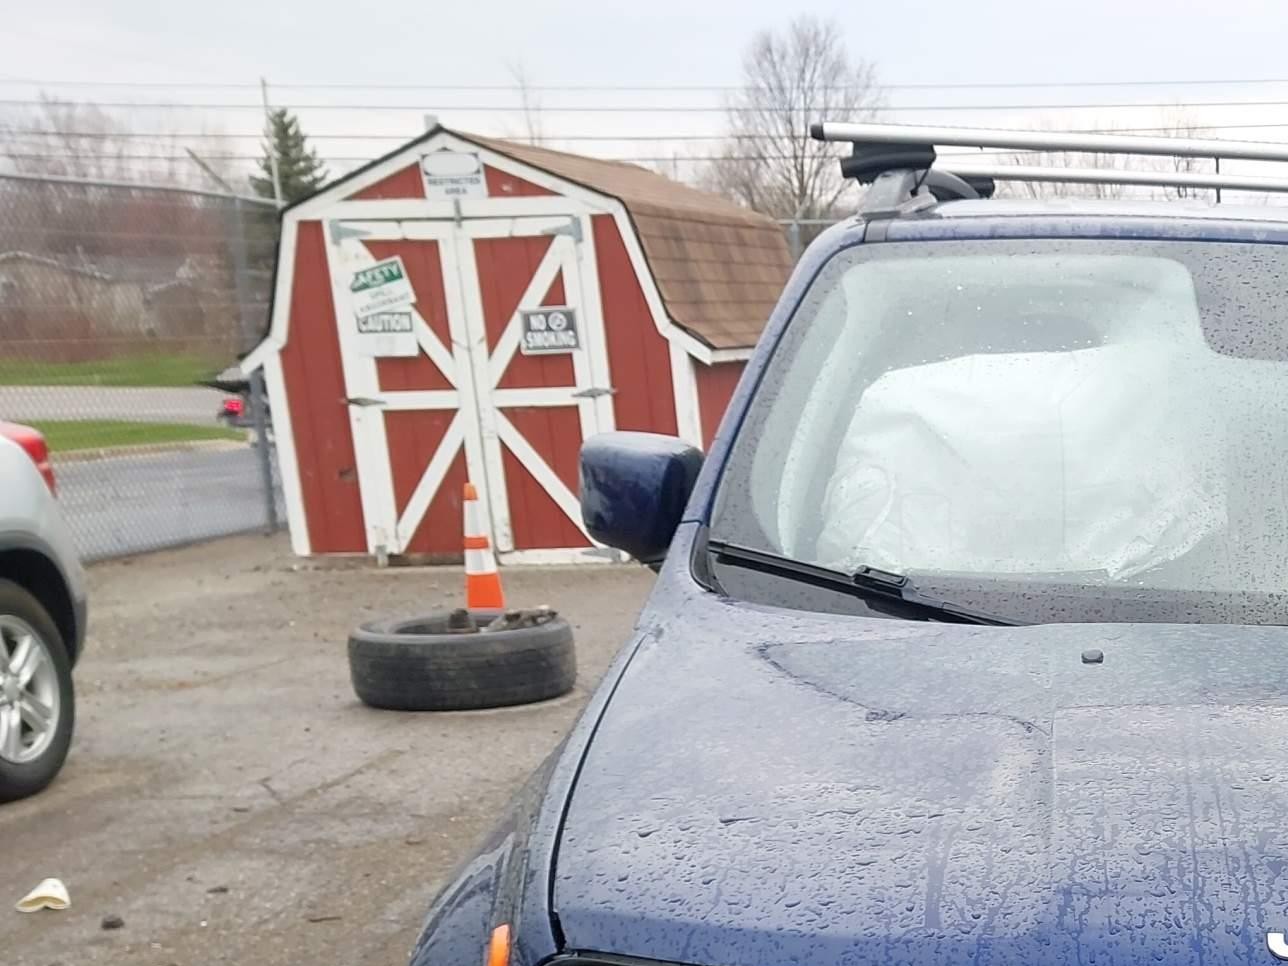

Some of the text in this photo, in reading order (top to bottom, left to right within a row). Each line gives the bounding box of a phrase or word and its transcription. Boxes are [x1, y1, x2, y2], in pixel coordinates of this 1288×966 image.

[360, 314, 411, 332] CAUTION
[530, 315, 547, 330] NO
[526, 331, 577, 348] SMOKING
